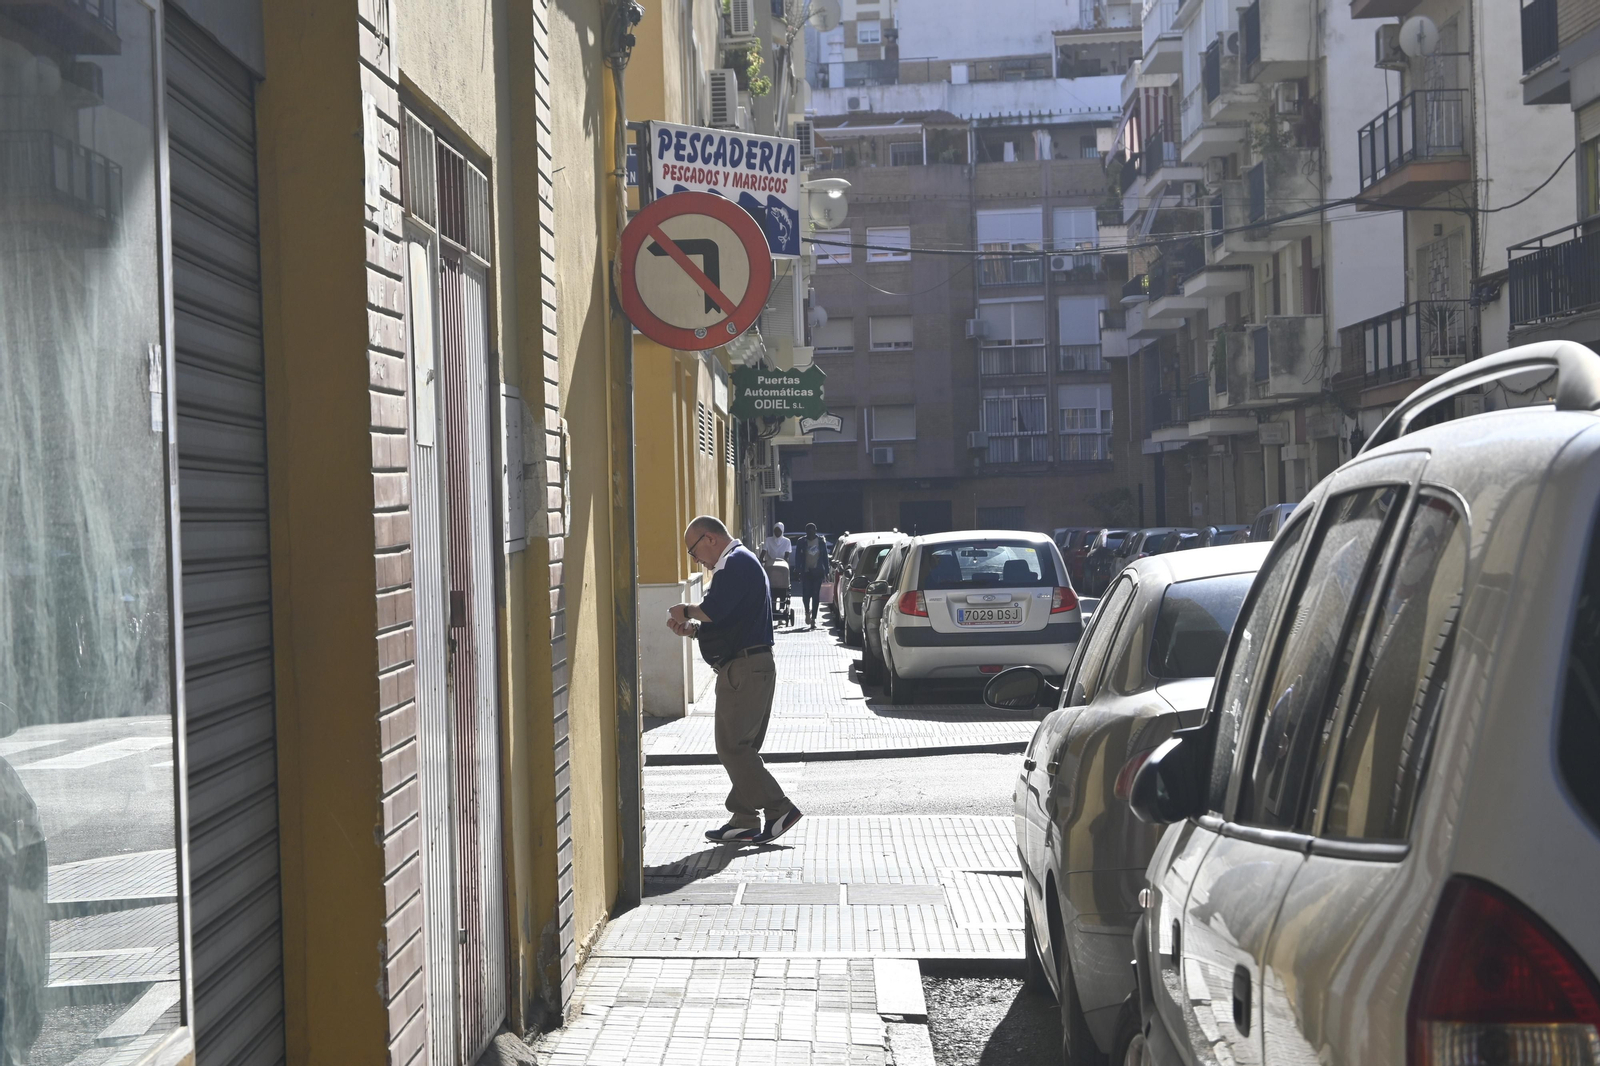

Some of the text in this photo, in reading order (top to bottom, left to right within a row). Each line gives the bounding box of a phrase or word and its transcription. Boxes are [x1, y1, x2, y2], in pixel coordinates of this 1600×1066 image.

[657, 128, 796, 175] PESCADERIA
[662, 163, 789, 194] PESCADOS Y MARISCOS
[757, 375, 800, 385] Puertas
[744, 387, 814, 397] Automáticas
[754, 399, 790, 409] ODIEL
[965, 608, 1018, 621] 7029 DSJ
